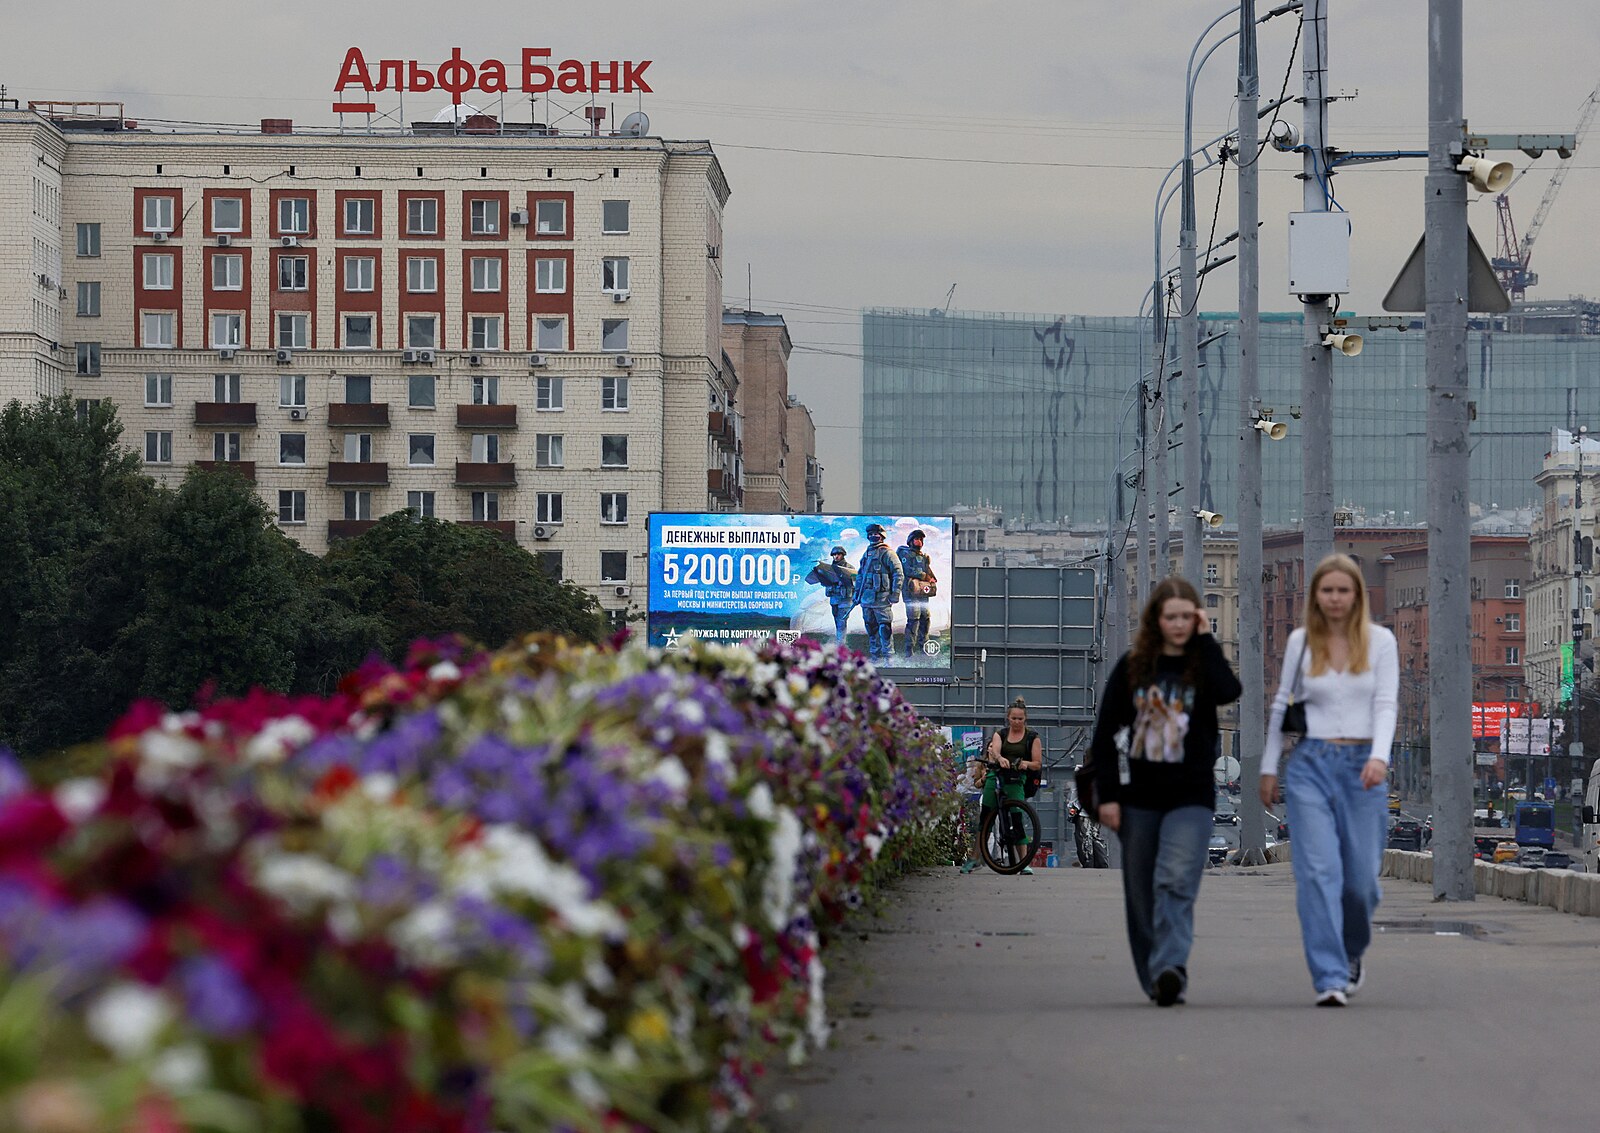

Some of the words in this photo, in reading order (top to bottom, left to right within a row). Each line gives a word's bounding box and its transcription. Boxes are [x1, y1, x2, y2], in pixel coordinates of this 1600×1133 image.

[333, 46, 508, 105] Альфа
[521, 47, 654, 93] Банк
[666, 530, 725, 544] ДЕНЕЖНЫЕ
[729, 531, 780, 544] ВЫПЛАТЫ
[784, 532, 796, 544] ОТ
[663, 590, 671, 598] ЗА
[672, 589, 693, 598] ПЕРВЫЙ
[694, 591, 704, 599] ГОД
[710, 591, 730, 599] УЧЕТОМ
[731, 591, 753, 599] ВЫПЛАТ
[754, 591, 798, 600] ПРАВИТЕЛЬСТВА
[706, 601, 747, 609] МИНИСТЕРСТВА
[748, 601, 774, 609] ОБОРОНЫ
[690, 629, 718, 638] СЛУЖБА
[720, 630, 730, 638] ПО
[731, 630, 770, 639] КОНТРАКТУ
[927, 643, 938, 653] 18+
